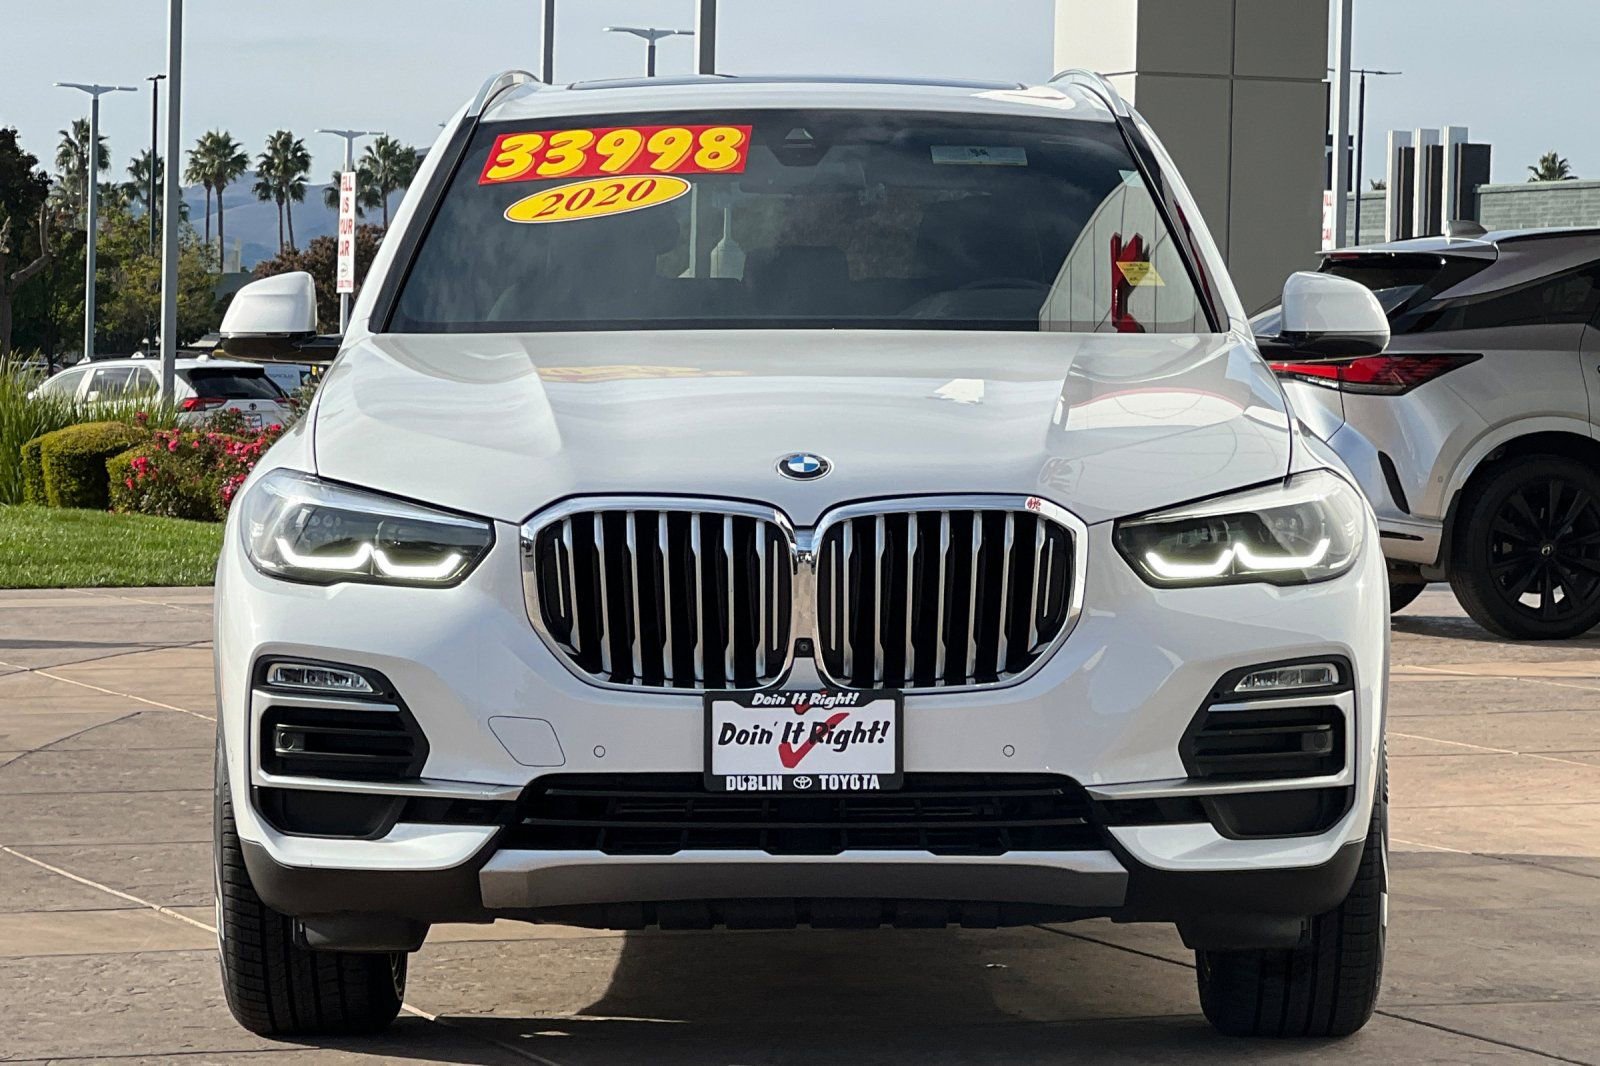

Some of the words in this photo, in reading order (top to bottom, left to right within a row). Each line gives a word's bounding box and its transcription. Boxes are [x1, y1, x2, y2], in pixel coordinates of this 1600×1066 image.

[485, 127, 746, 181] 33998
[531, 178, 657, 219] 2020
[751, 692, 790, 706] Doin'
[791, 692, 808, 705] It
[808, 692, 860, 709] Right!
[717, 720, 779, 746] Doin'
[781, 720, 805, 745] It
[809, 720, 891, 752] Right!
[725, 775, 783, 791] DUBLIN
[818, 774, 881, 791] TOYOTA
